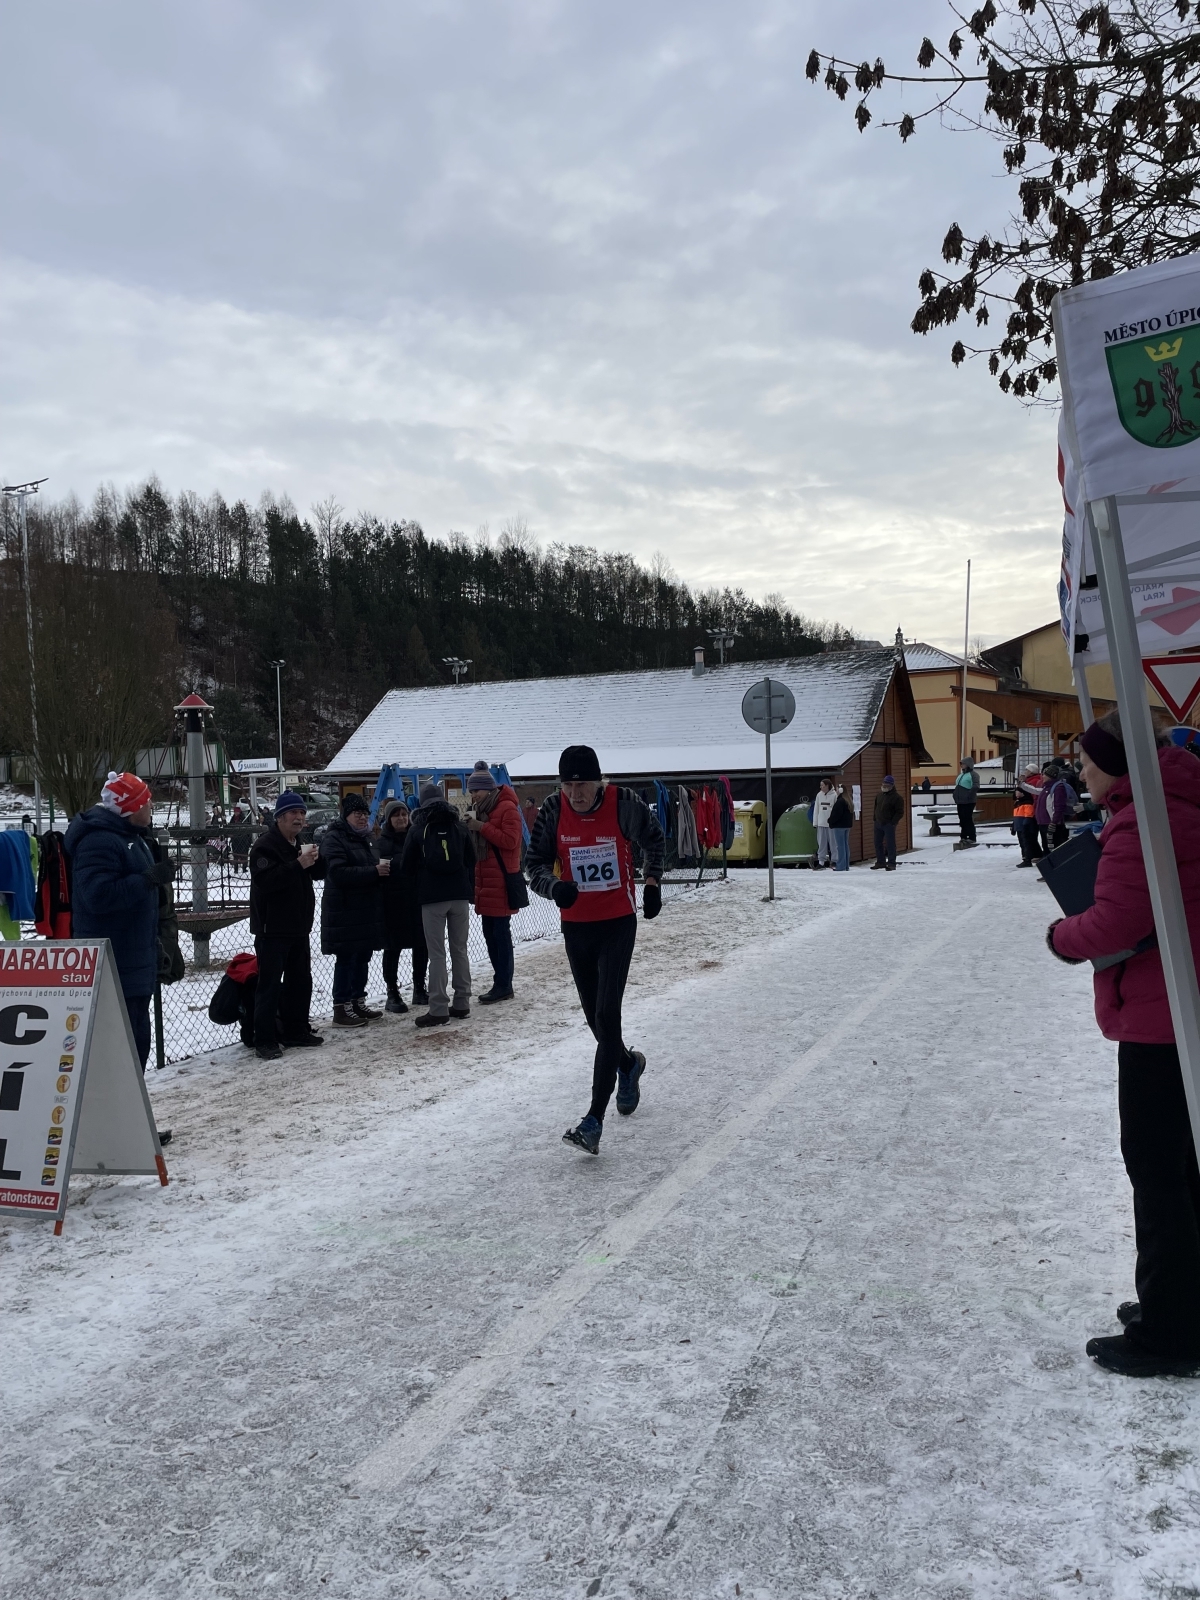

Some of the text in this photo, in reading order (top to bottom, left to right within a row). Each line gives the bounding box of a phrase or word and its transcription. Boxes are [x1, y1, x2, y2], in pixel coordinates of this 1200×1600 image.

[1103, 317, 1161, 344] MĚSTO
[576, 862, 614, 882] 126
[62, 973, 90, 983] stav
[35, 989, 65, 998] jednota
[69, 989, 92, 998] Úpice
